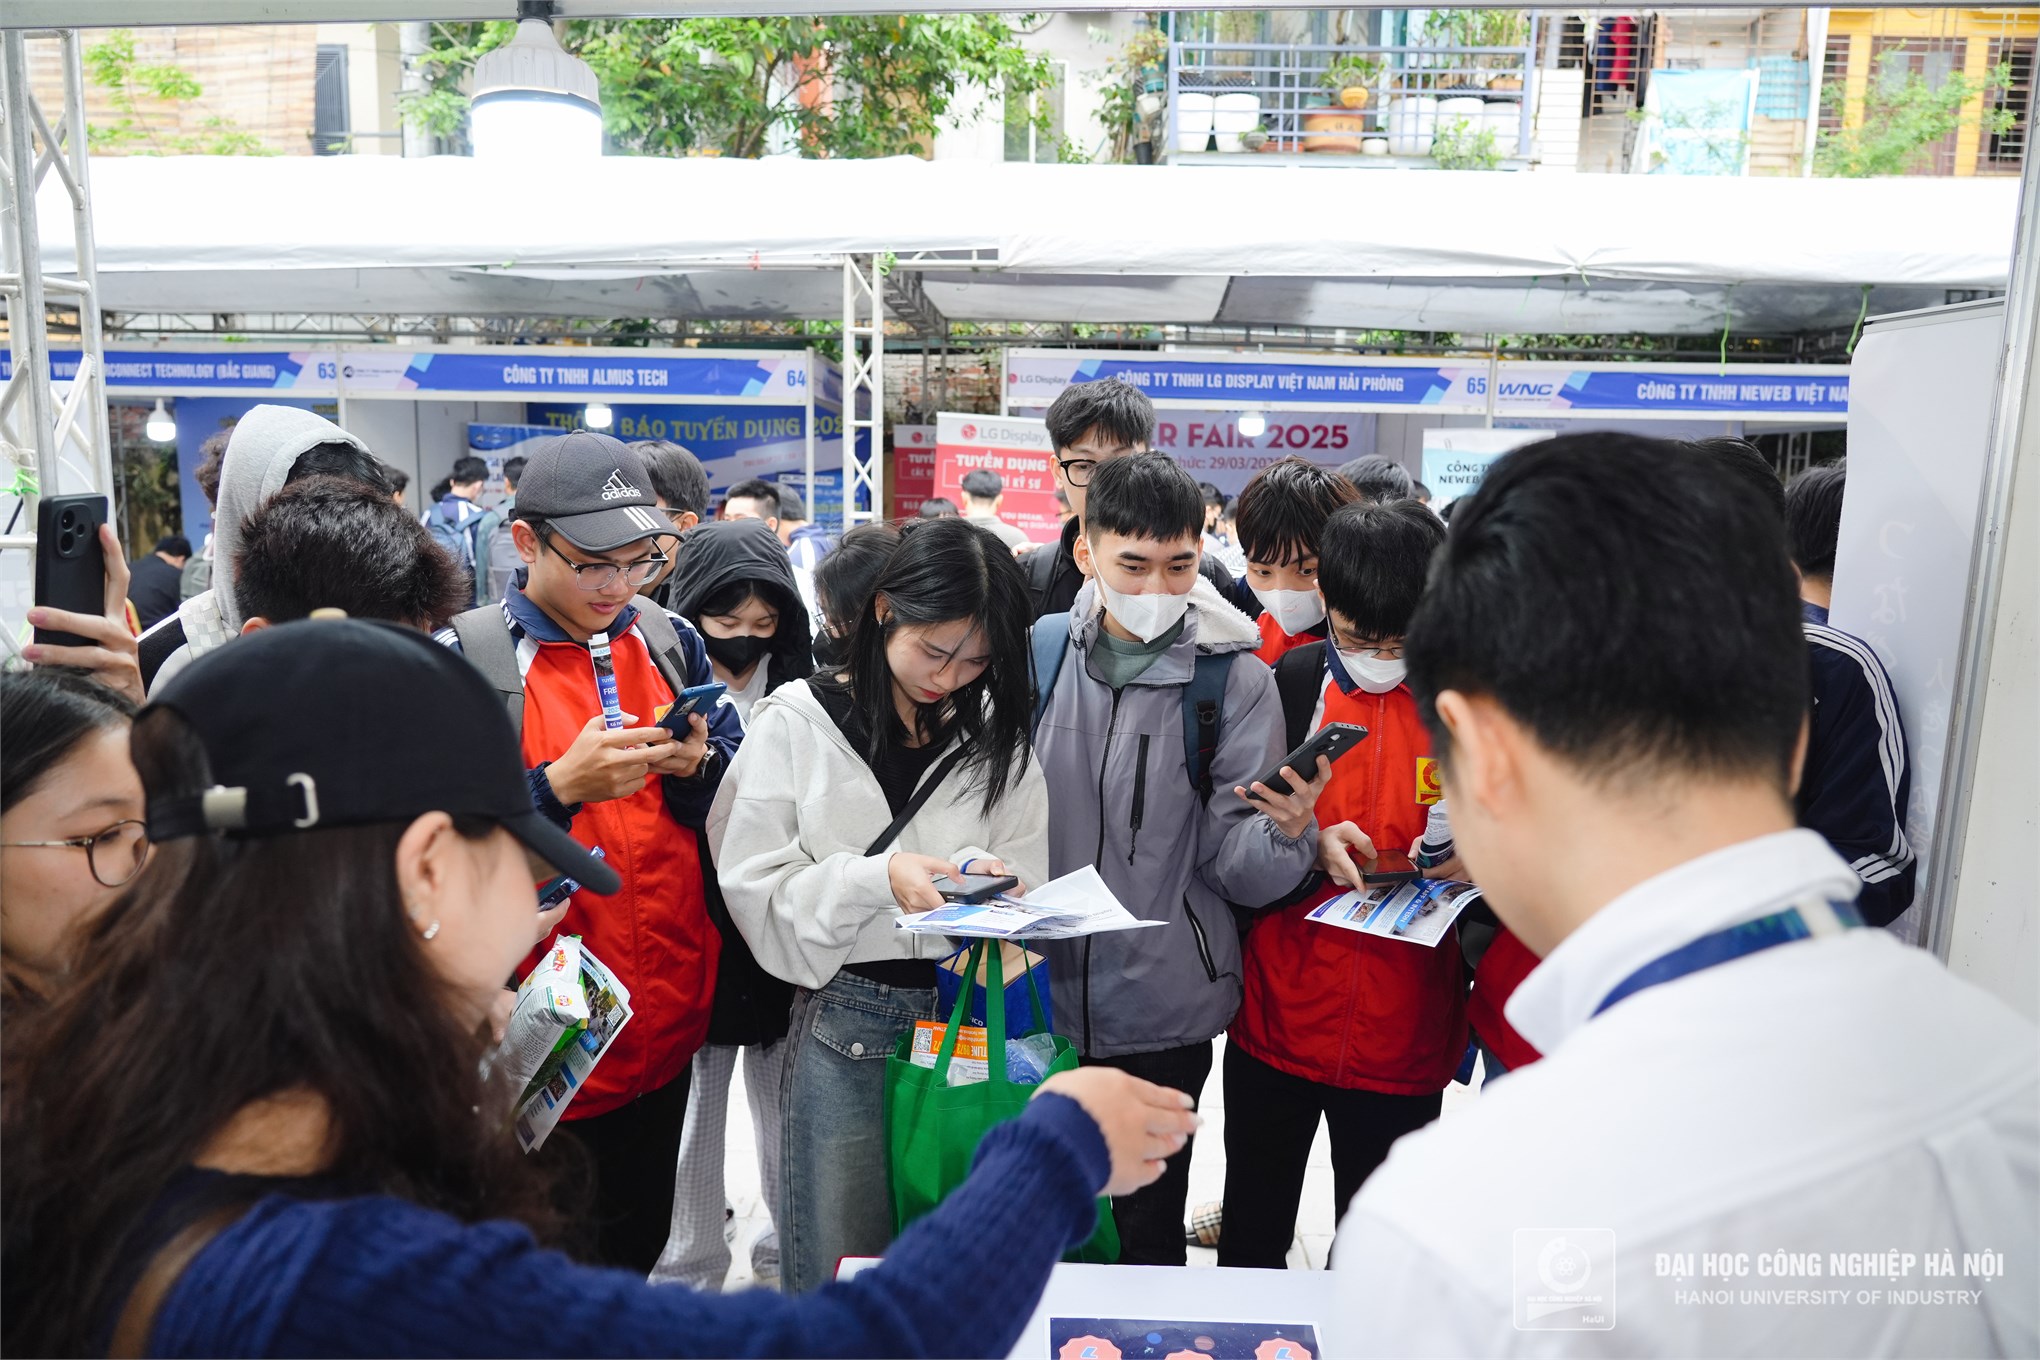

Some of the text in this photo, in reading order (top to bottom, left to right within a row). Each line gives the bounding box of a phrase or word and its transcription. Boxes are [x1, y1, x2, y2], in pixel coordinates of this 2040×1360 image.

[154, 363, 215, 379] TECHNOLOGY
[317, 362, 337, 379] 63
[503, 363, 668, 387] CÔNG TY TNHH ALMUS TECH
[787, 369, 806, 387] 64
[1020, 375, 1068, 387] LG Display
[1117, 369, 1404, 393] CÔNG TY TNHH LG DISPLAY VIỆT NAM HẢI PHÒNG
[1466, 377, 1487, 395] 65
[1498, 383, 1553, 397] WNC
[1637, 380, 1676, 400] CÔNG
[1679, 384, 1698, 401] TY
[1700, 383, 1737, 401] TNHH
[1740, 384, 1792, 402] NEWEB
[1795, 382, 1825, 405] VIỆT
[621, 415, 666, 438] BÁO
[671, 415, 738, 441] TUYỂN
[744, 417, 800, 443] DỤNG
[980, 427, 1045, 446] LG Display
[1266, 424, 1349, 449] 2025
[1007, 457, 1047, 473] DỤNG
[1447, 460, 1478, 472] CÔNG
[601, 488, 641, 500] adidas
